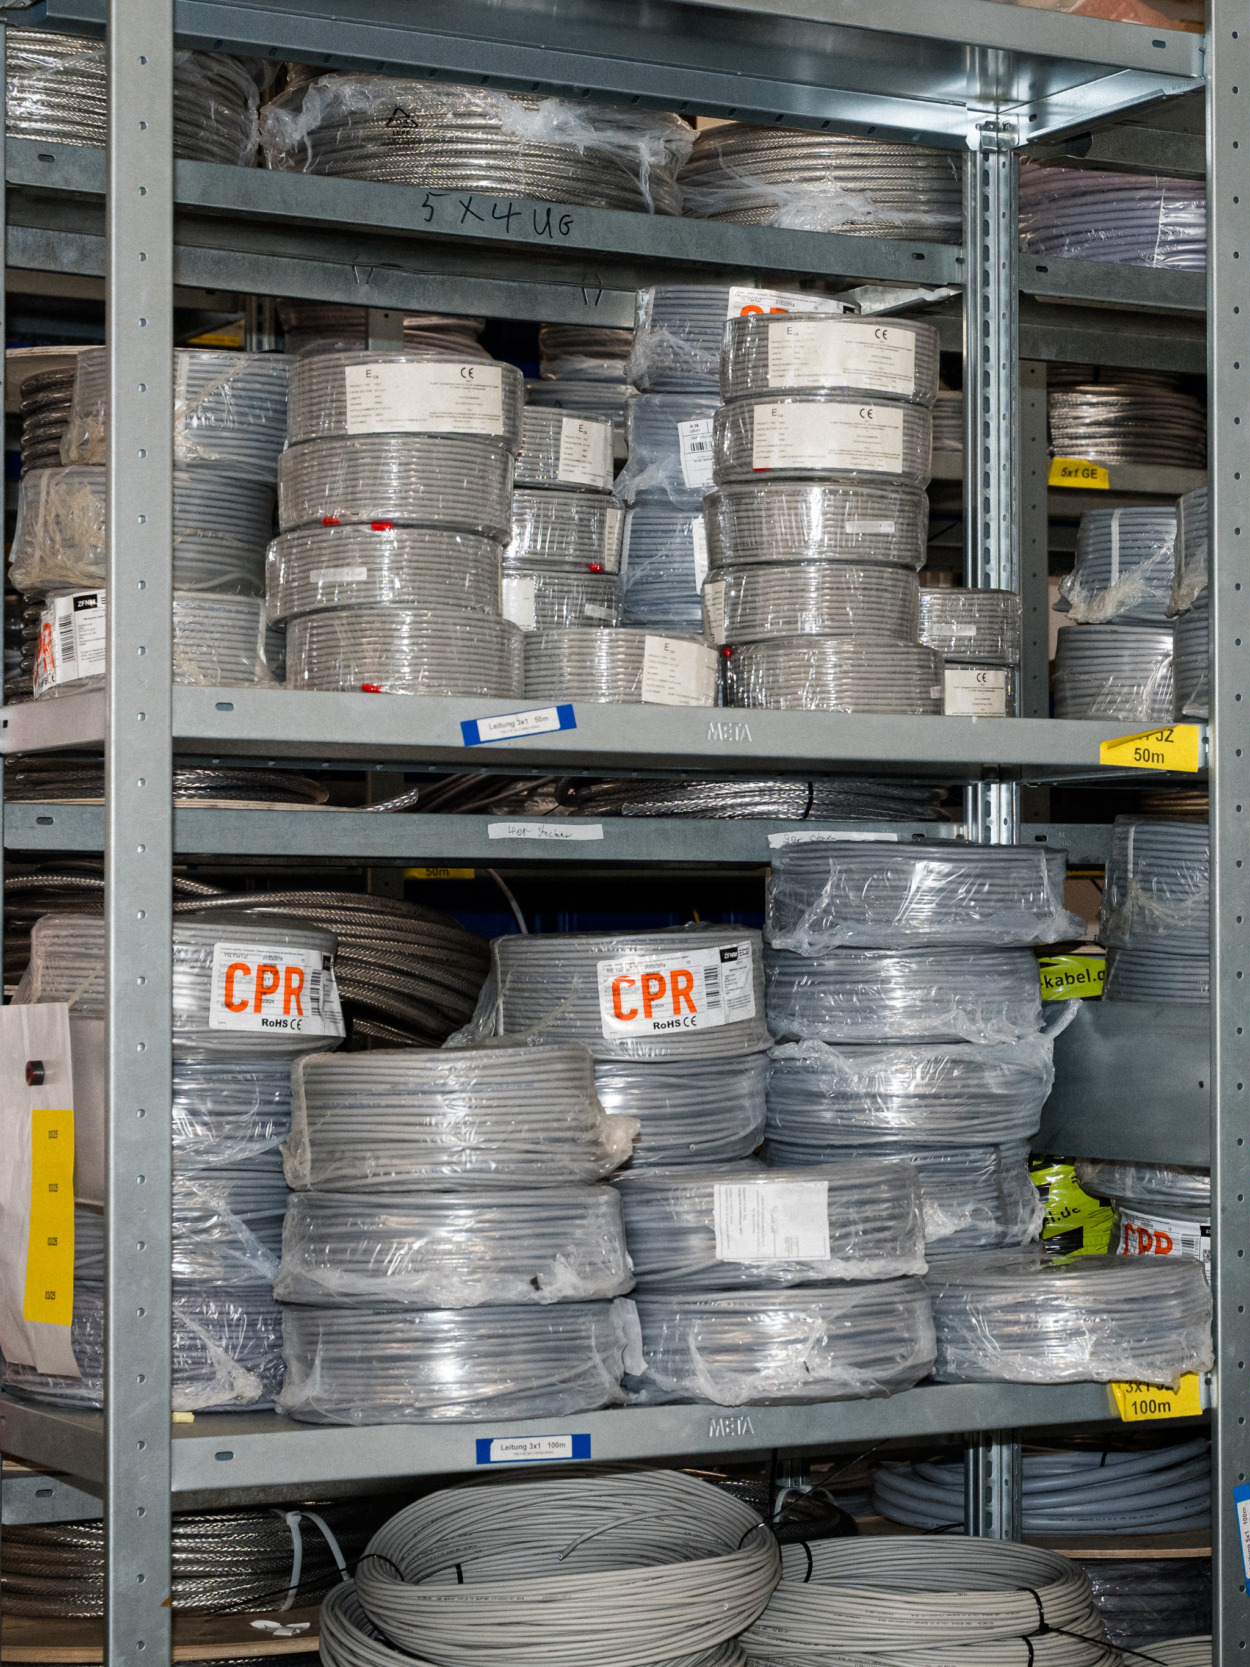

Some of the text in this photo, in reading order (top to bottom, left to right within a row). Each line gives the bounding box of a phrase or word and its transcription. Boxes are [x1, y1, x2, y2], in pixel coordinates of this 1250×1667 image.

[422, 191, 450, 222] 5
[491, 202, 522, 233] 4
[1061, 466, 1098, 480] 5x1 GE
[1134, 747, 1165, 764] 50m
[224, 961, 305, 1017] CPR
[611, 968, 698, 1022] CPR
[261, 1018, 289, 1028] RoHS
[653, 1019, 682, 1031] RoHS
[1131, 1400, 1172, 1416] 100m
[500, 1441, 566, 1452] Leitung 3x1 100m
